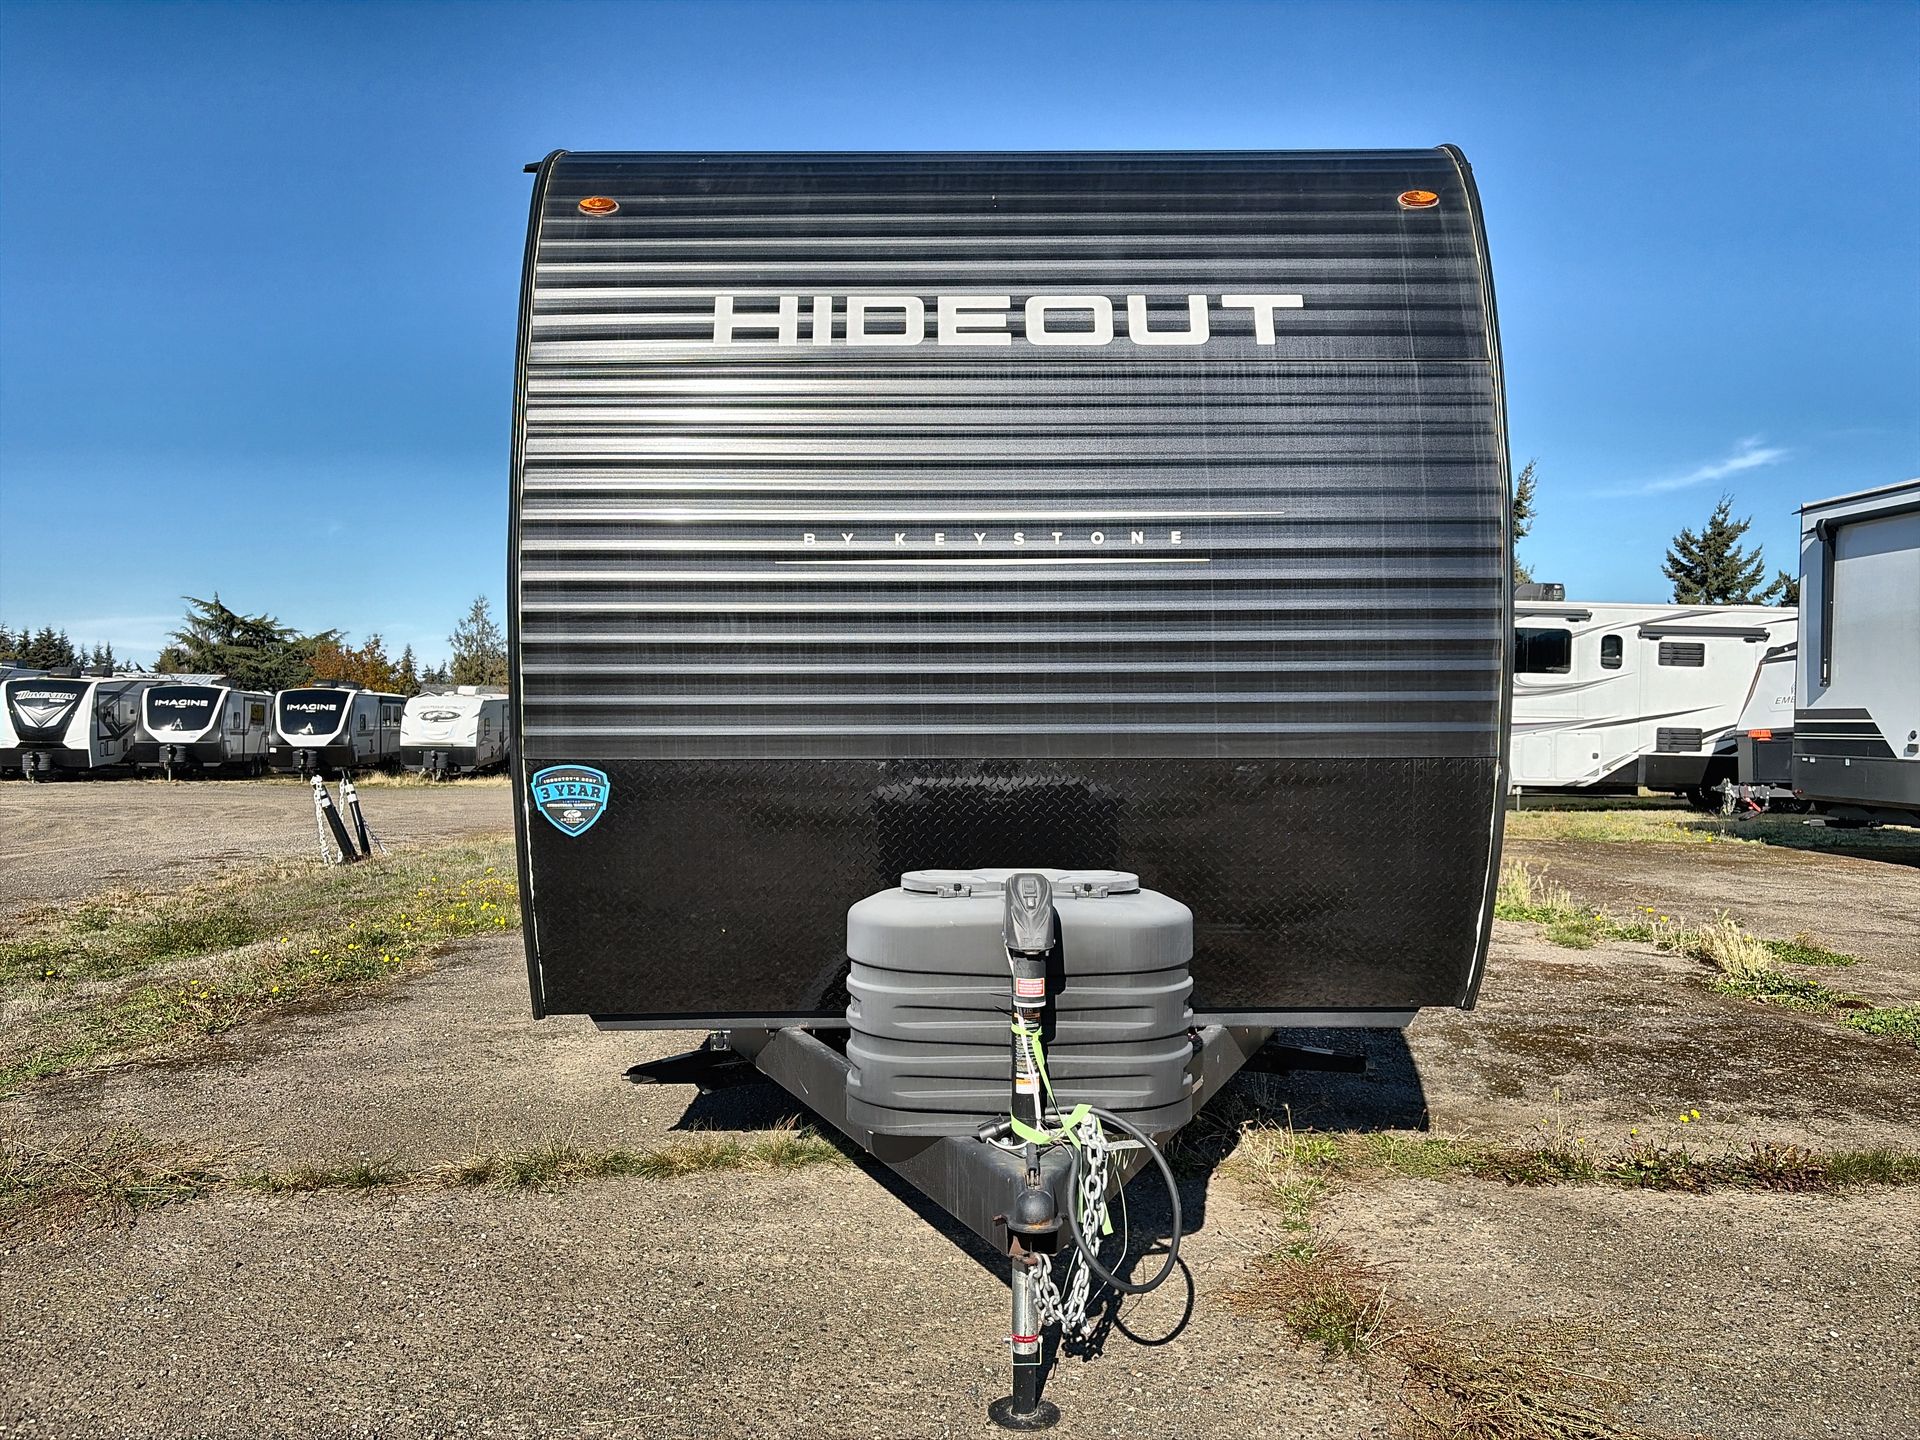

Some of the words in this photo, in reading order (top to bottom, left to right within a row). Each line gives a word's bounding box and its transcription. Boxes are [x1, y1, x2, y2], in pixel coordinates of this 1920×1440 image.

[713, 294, 1304, 346] HIDEOUT
[803, 533, 854, 546] BY
[894, 531, 1182, 546] KEYSTONE
[154, 699, 208, 707] IMAGINE
[286, 703, 337, 711] IMAGINE
[540, 787, 551, 800] 3
[554, 785, 600, 798] YEAR
